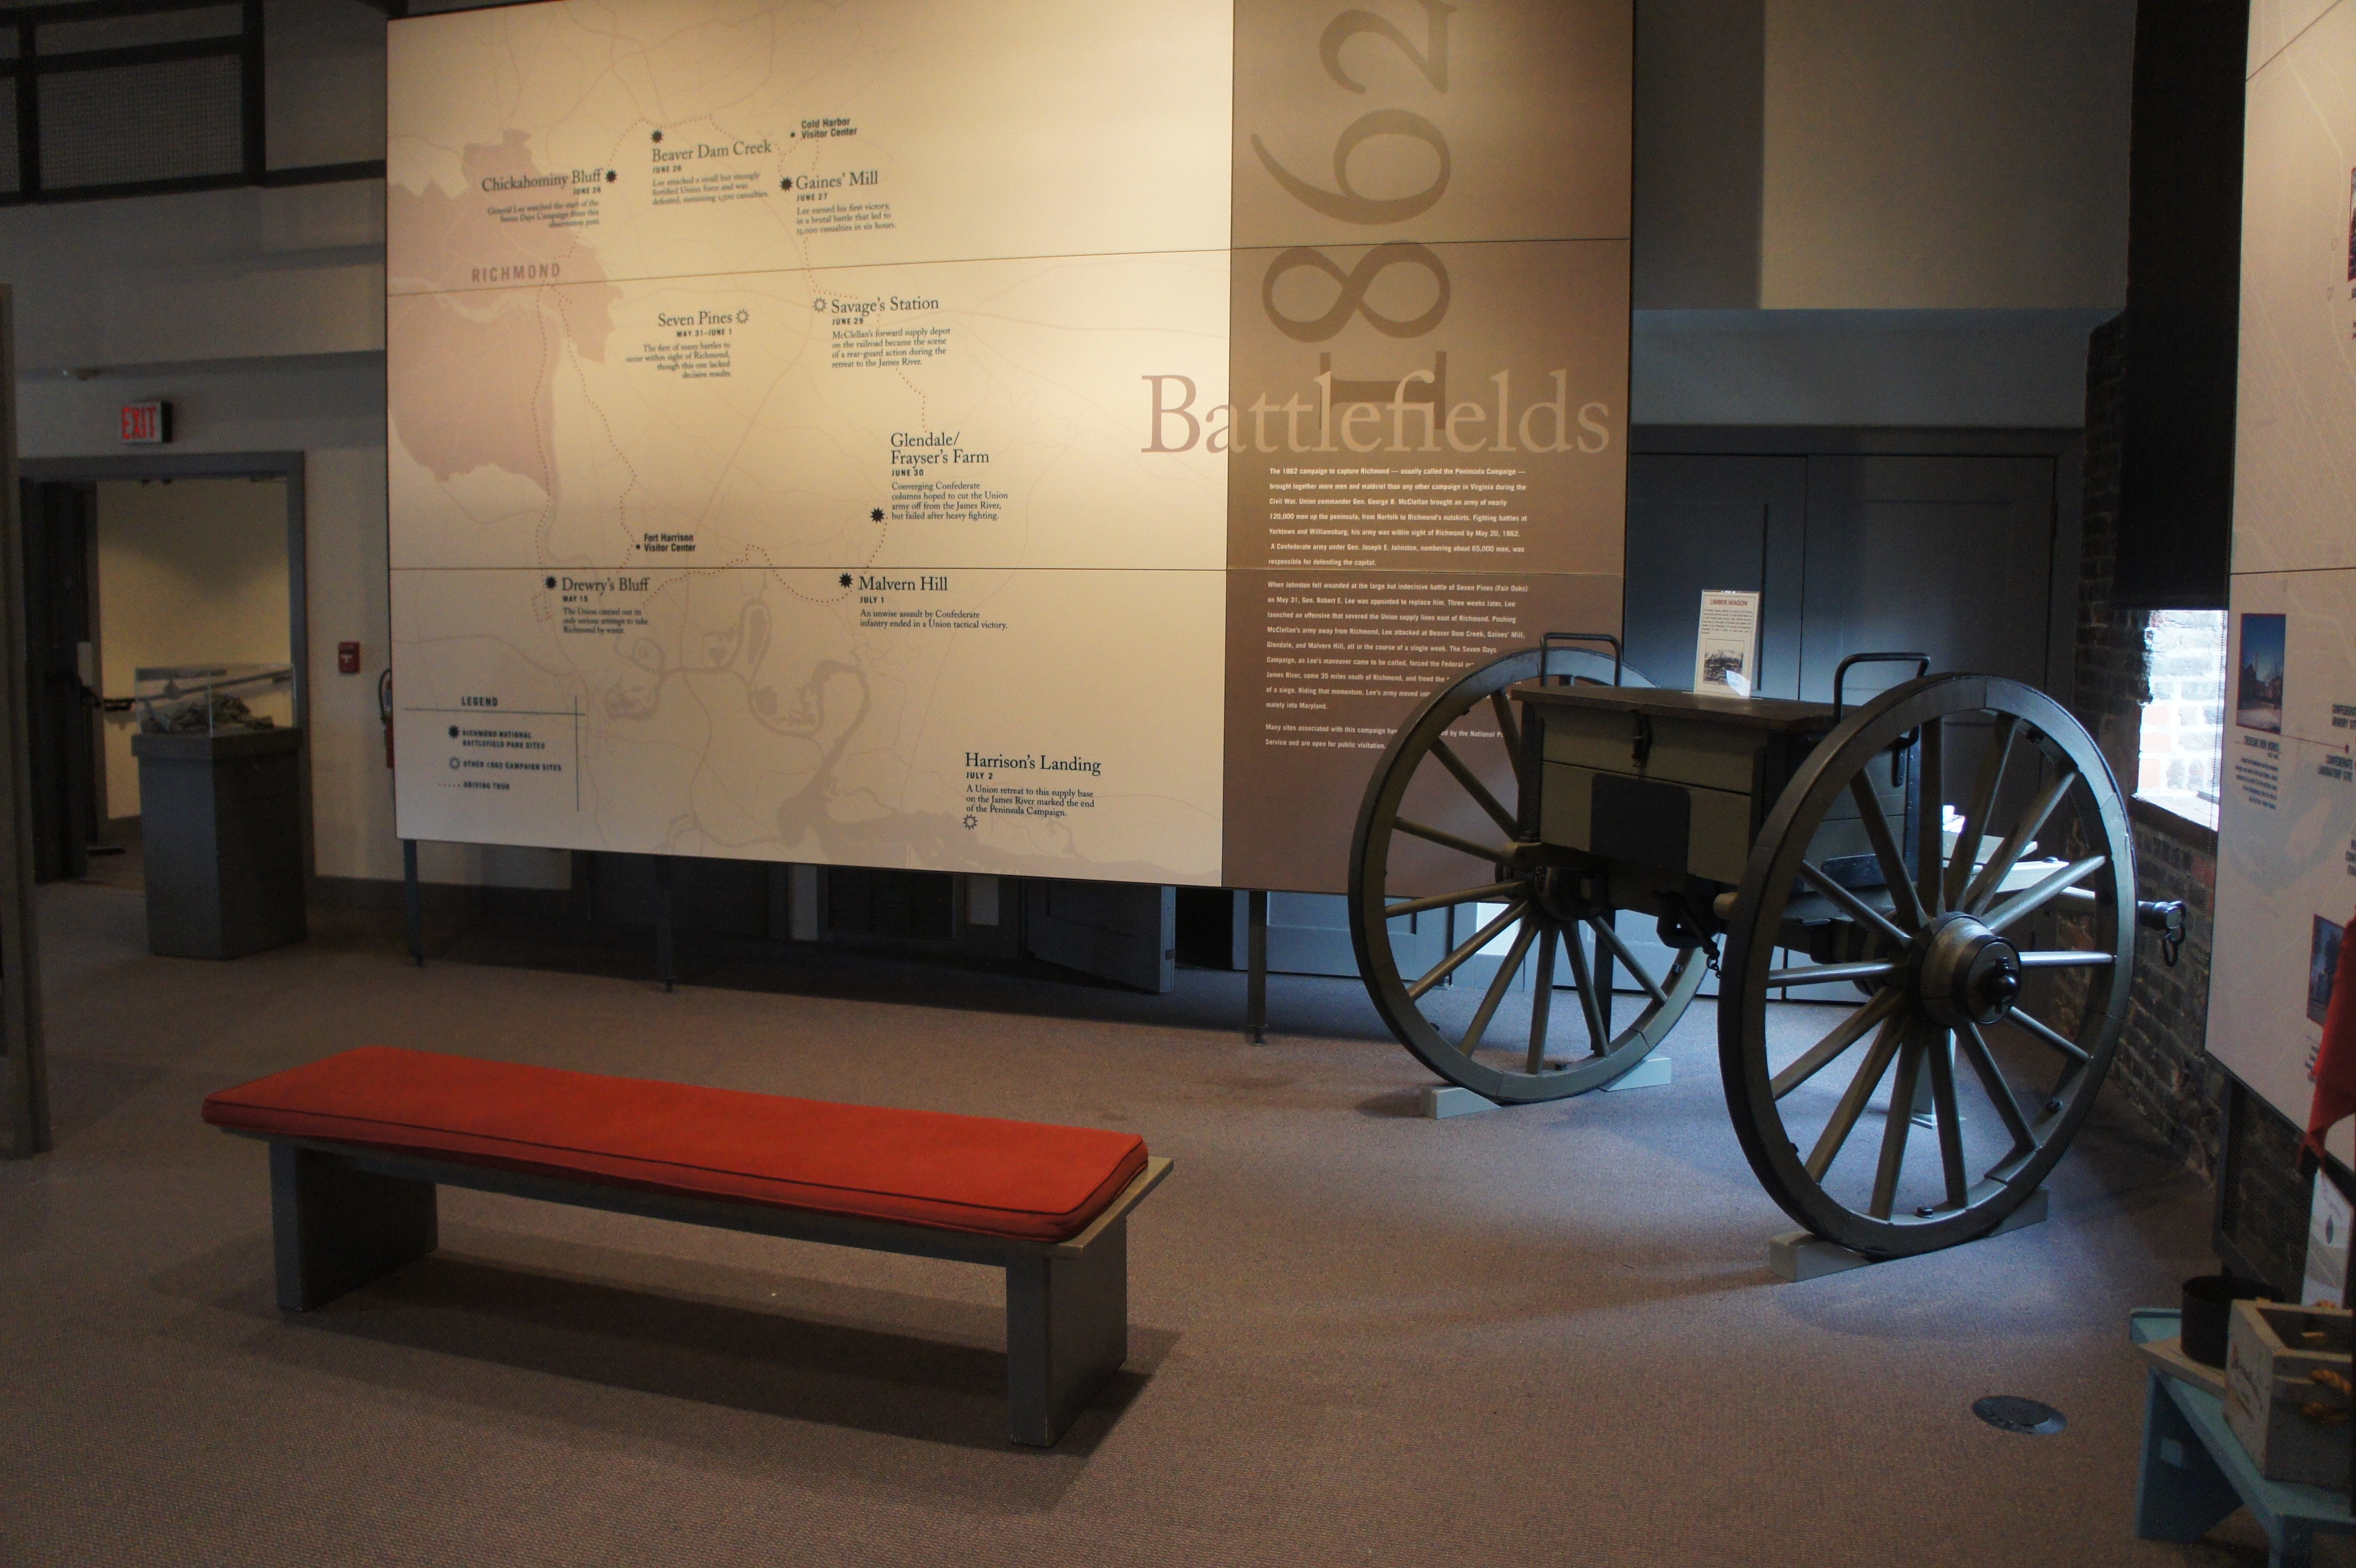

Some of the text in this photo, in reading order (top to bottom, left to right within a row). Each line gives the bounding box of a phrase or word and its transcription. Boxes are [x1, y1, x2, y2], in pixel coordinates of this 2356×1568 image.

[801, 117, 850, 129] Cold Harbor
[801, 127, 857, 139] Visitor Center
[652, 139, 771, 162] Beaver Dam Creek
[481, 168, 603, 191] Chickahominy Bluff
[795, 170, 878, 190] Gaines' Mill
[796, 192, 827, 201] JUNE 27
[1250, 0, 1451, 430] 1862
[472, 262, 560, 282] RICHMOND
[831, 296, 938, 317] Savage's Station
[658, 310, 732, 327] Seven Pines
[832, 327, 950, 339] McClellan's forward supply depot
[842, 340, 854, 348] the
[856, 339, 883, 347] railroad
[831, 349, 840, 358] of
[847, 348, 883, 360] rear-guard
[885, 349, 907, 357] action
[909, 347, 933, 357] during
[934, 346, 946, 355] the
[865, 359, 876, 367] the
[878, 358, 899, 368] James
[1141, 369, 1610, 455] Battlefields
[122, 407, 156, 439] EXIT
[891, 448, 989, 468] Frayser's Farm
[891, 481, 980, 492] Converging Confederate
[1495, 483, 1515, 492] during
[923, 491, 946, 502] hoped
[970, 491, 982, 499] the
[984, 491, 1008, 499] Union
[891, 504, 909, 512] army
[911, 501, 922, 509] off
[923, 501, 940, 510] from
[943, 501, 954, 509] the
[956, 501, 977, 512] James
[891, 512, 904, 520] but
[905, 511, 925, 519] failed
[927, 511, 944, 519] after
[946, 511, 966, 521] heavy
[1472, 514, 1497, 522] Fighting
[643, 533, 693, 542] Fort Harrison
[643, 543, 696, 552] Visitor Center
[561, 577, 650, 595] Drewry's Bluff
[858, 576, 947, 591] Malvern Hill
[860, 609, 871, 617] An
[925, 610, 933, 620] by
[935, 610, 979, 618] Confederate
[860, 618, 888, 629] infantry
[889, 619, 911, 627] ended
[913, 619, 920, 628] in
[928, 619, 951, 628] Union
[953, 620, 979, 628] tactical
[461, 696, 498, 707] LEGEND
[965, 752, 1101, 776] Harrison's Landing
[966, 784, 973, 792] A
[975, 784, 998, 794] Union
[1035, 787, 1049, 796] this
[1051, 789, 1075, 799] supply
[1077, 789, 1093, 798] base
[977, 794, 989, 803] the
[991, 795, 1012, 807] James
[1015, 796, 1034, 805] River
[1037, 797, 1064, 806] marked
[1067, 798, 1078, 807] the
[1080, 799, 1094, 808] end
[966, 803, 975, 812] of
[975, 803, 987, 812] the
[989, 803, 1024, 814] Peninsula
